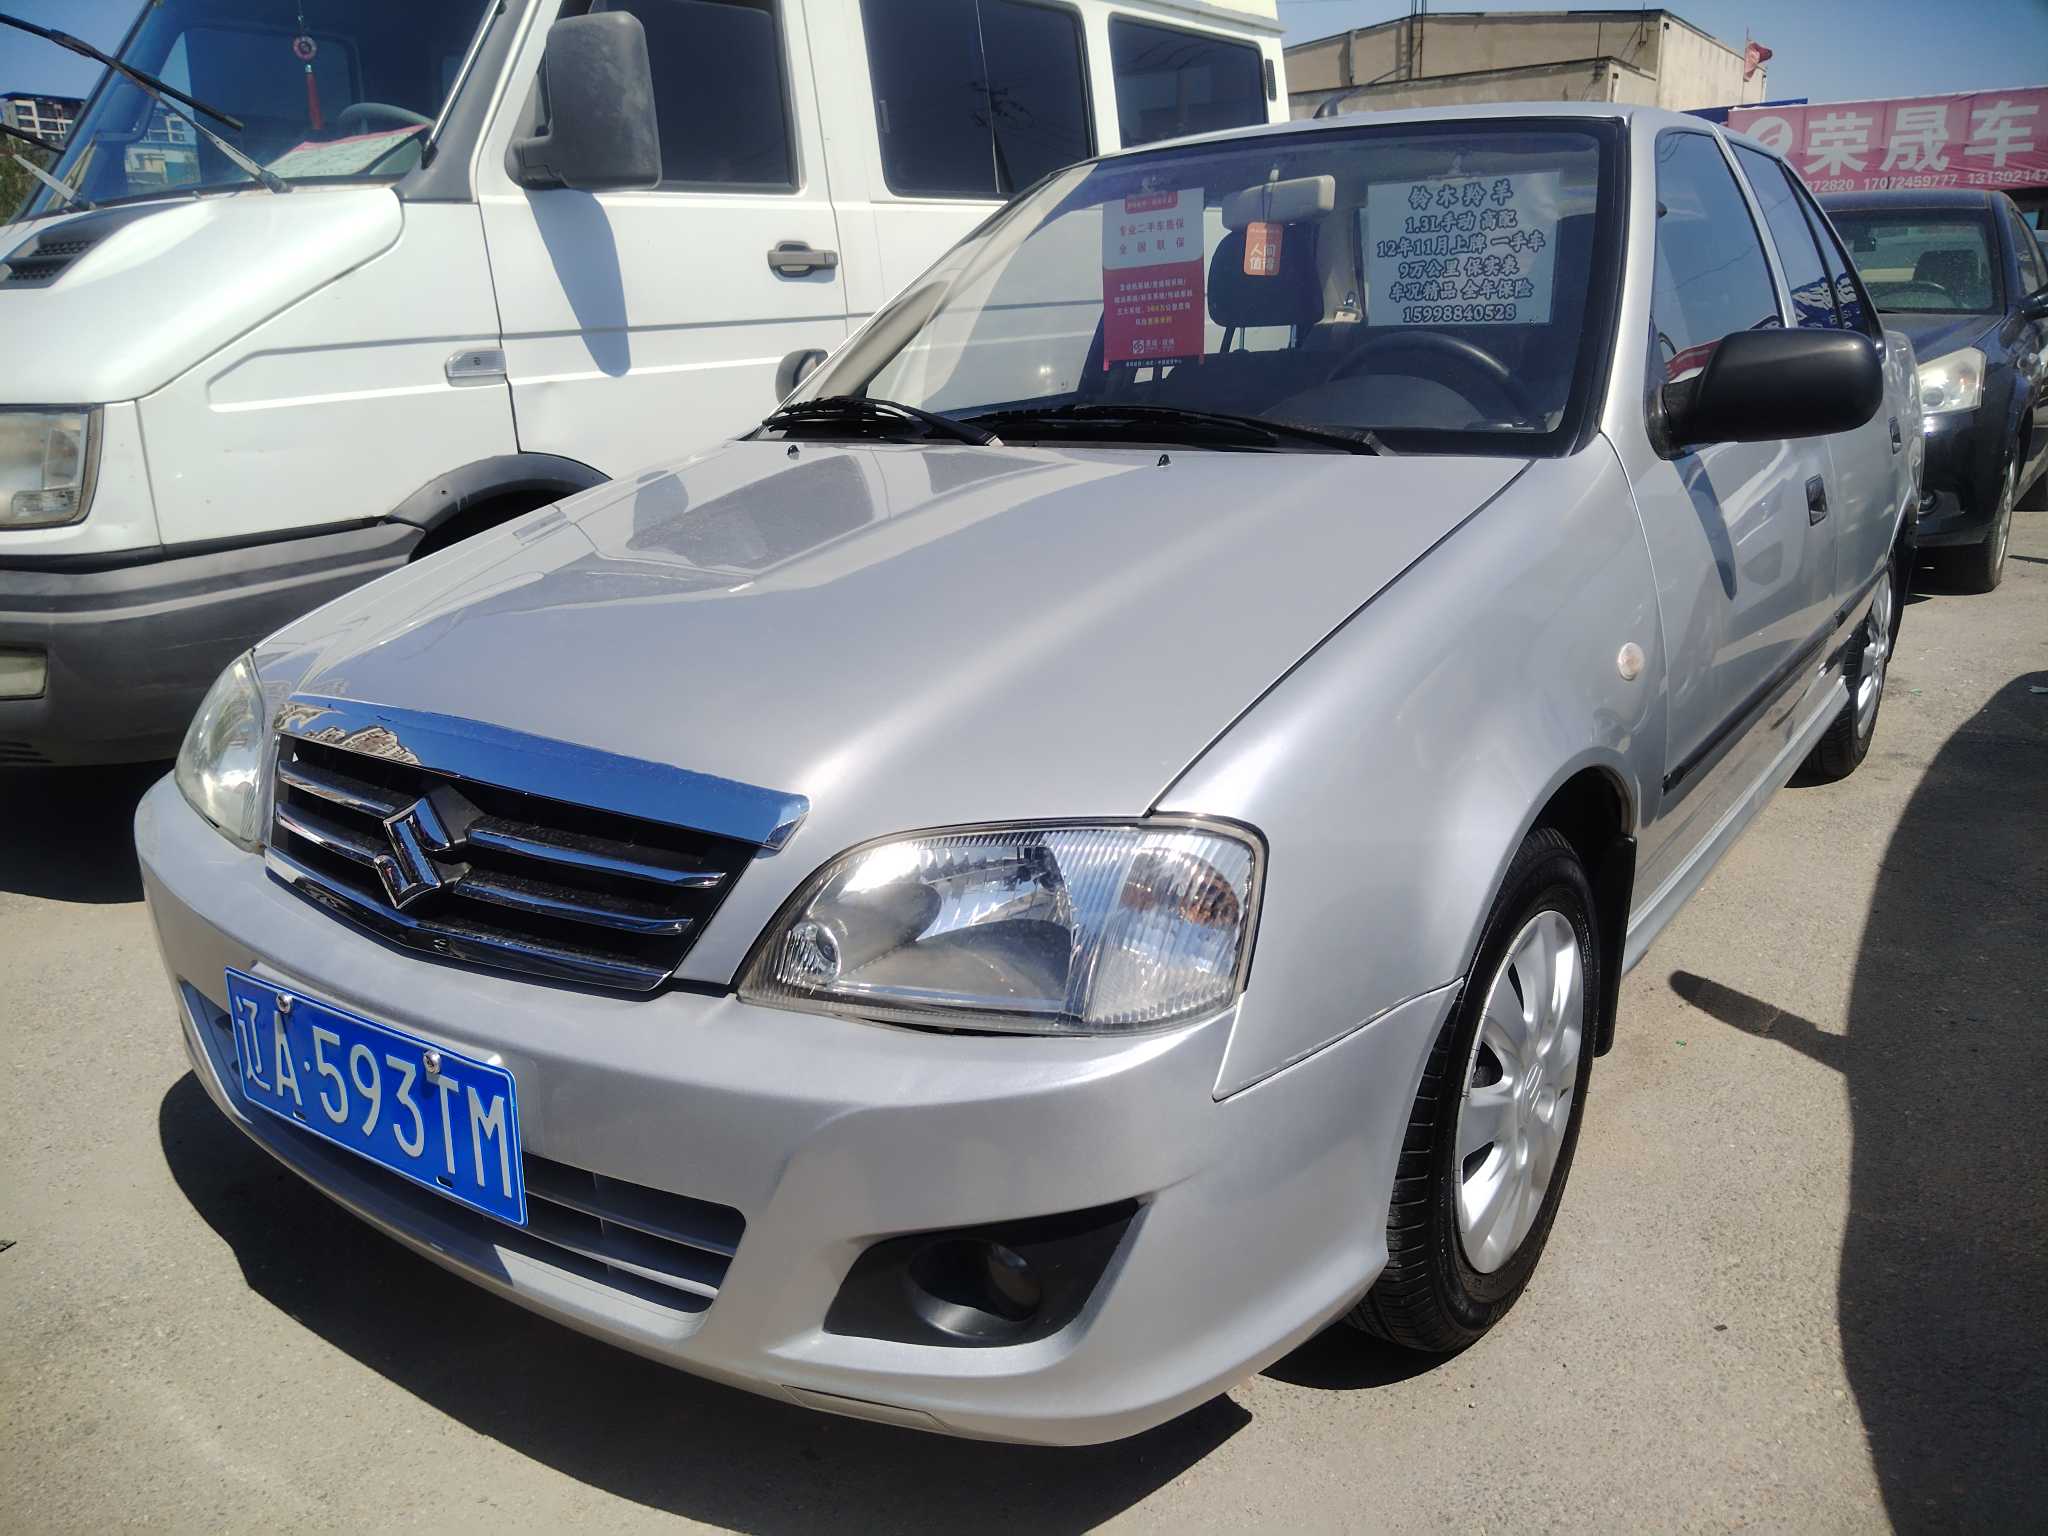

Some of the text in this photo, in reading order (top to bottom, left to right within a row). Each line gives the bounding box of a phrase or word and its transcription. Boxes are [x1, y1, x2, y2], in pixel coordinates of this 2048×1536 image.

[1802, 99, 2040, 177] 荣晟车
[1405, 211, 1475, 233] 1.3L手动
[1377, 230, 1546, 258] 12年11月上牌 一手车
[1398, 257, 1460, 279] 9万公里
[1389, 277, 1535, 302] 车况精品 全年保险
[1403, 303, 1516, 324] 15998840528
